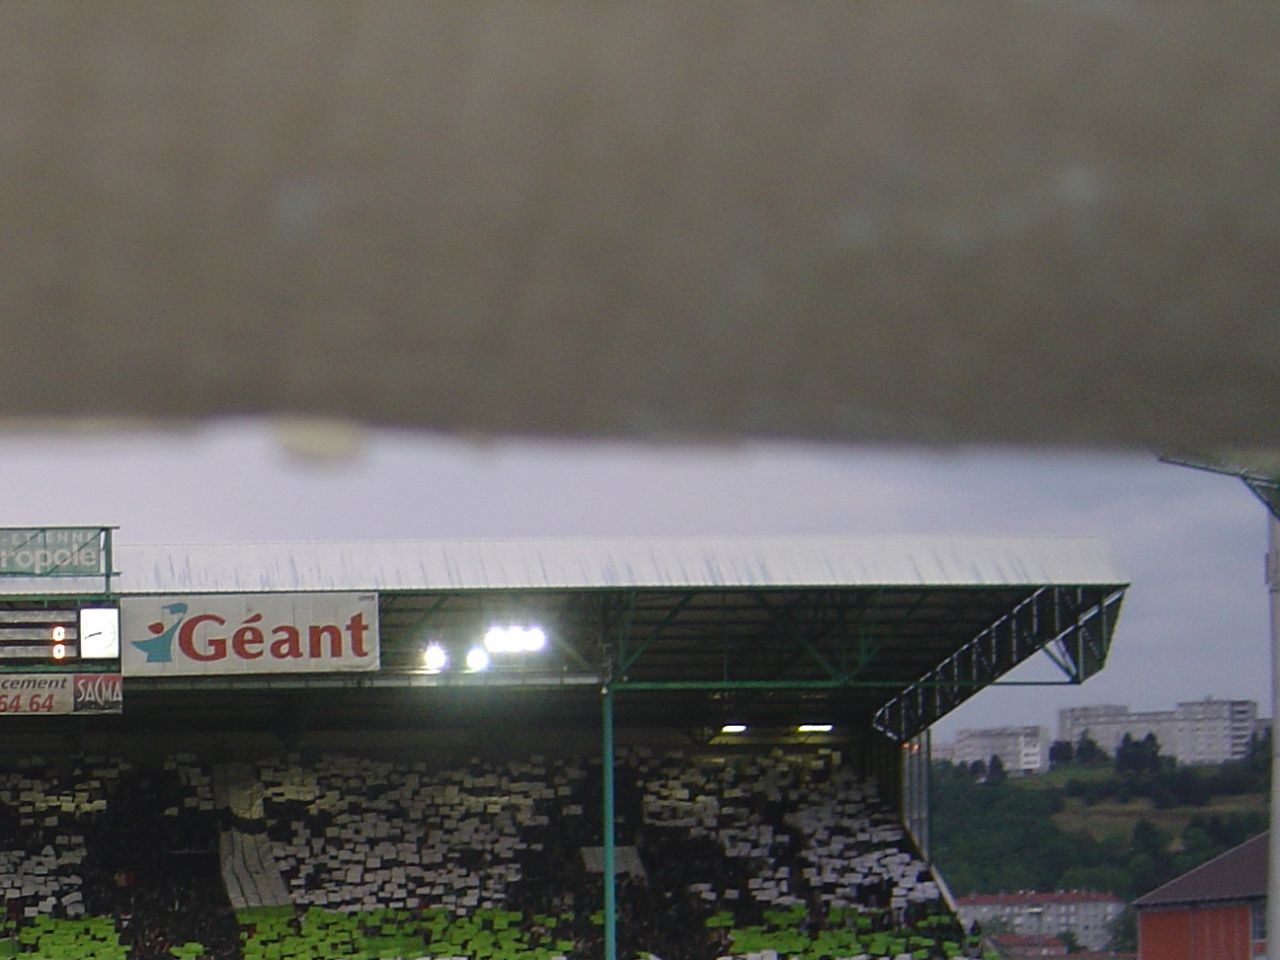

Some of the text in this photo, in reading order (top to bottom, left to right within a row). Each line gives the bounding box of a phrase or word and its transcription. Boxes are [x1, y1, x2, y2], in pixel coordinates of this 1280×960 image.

[178, 612, 369, 662] Géant
[29, 693, 55, 712] 64
[77, 675, 122, 706] SACMA
